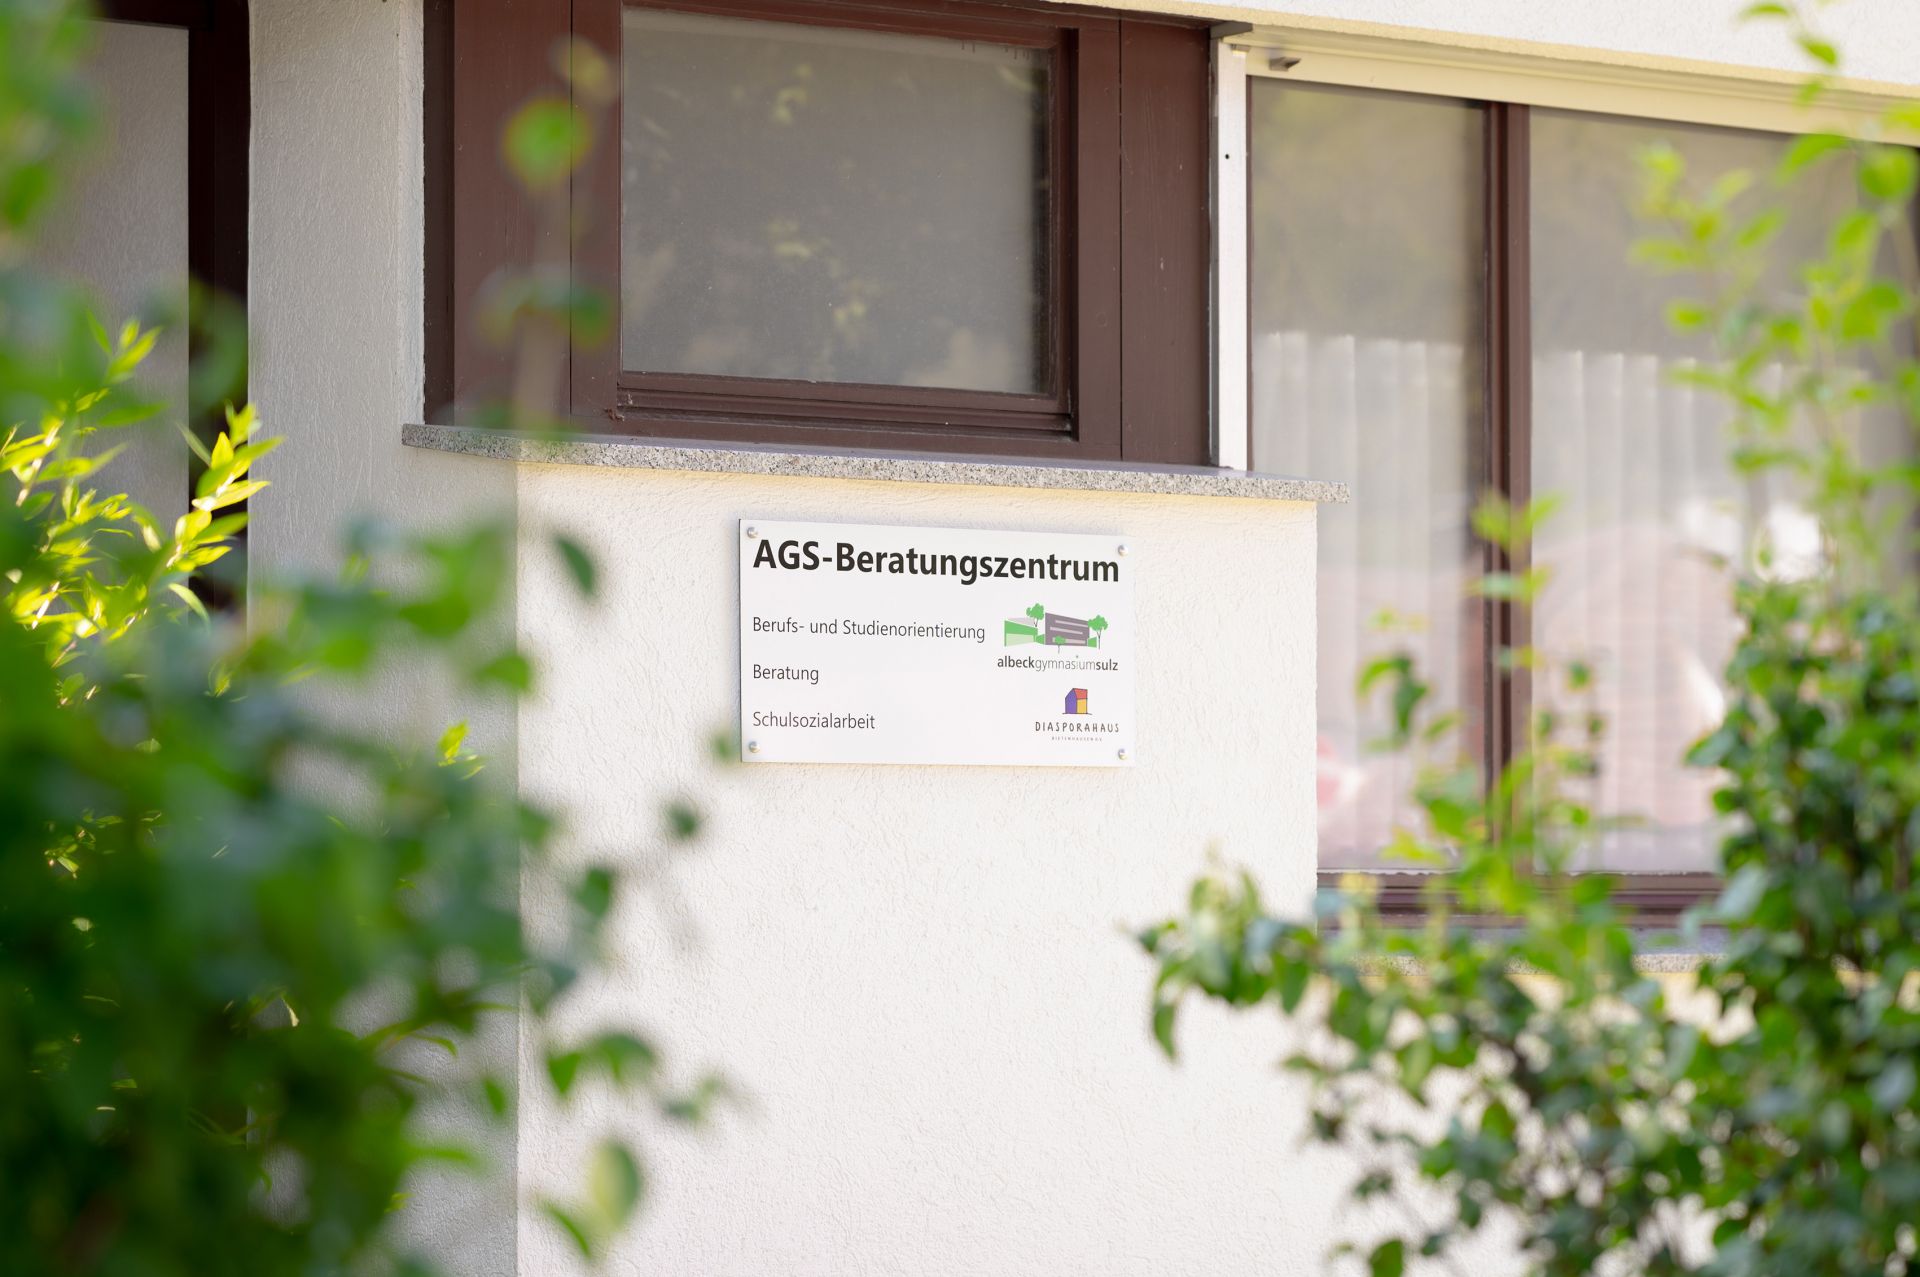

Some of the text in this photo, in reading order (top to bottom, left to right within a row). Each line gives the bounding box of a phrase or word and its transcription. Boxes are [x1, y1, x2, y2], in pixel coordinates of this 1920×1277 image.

[753, 539, 1119, 585] AGS-Beratungszentrum
[753, 616, 985, 644] Berufs- und Studienorientierung
[753, 663, 819, 685] Beratung
[752, 711, 876, 730] Schulsozialarbeit
[1035, 721, 1119, 733] DIASPORAHAUS
